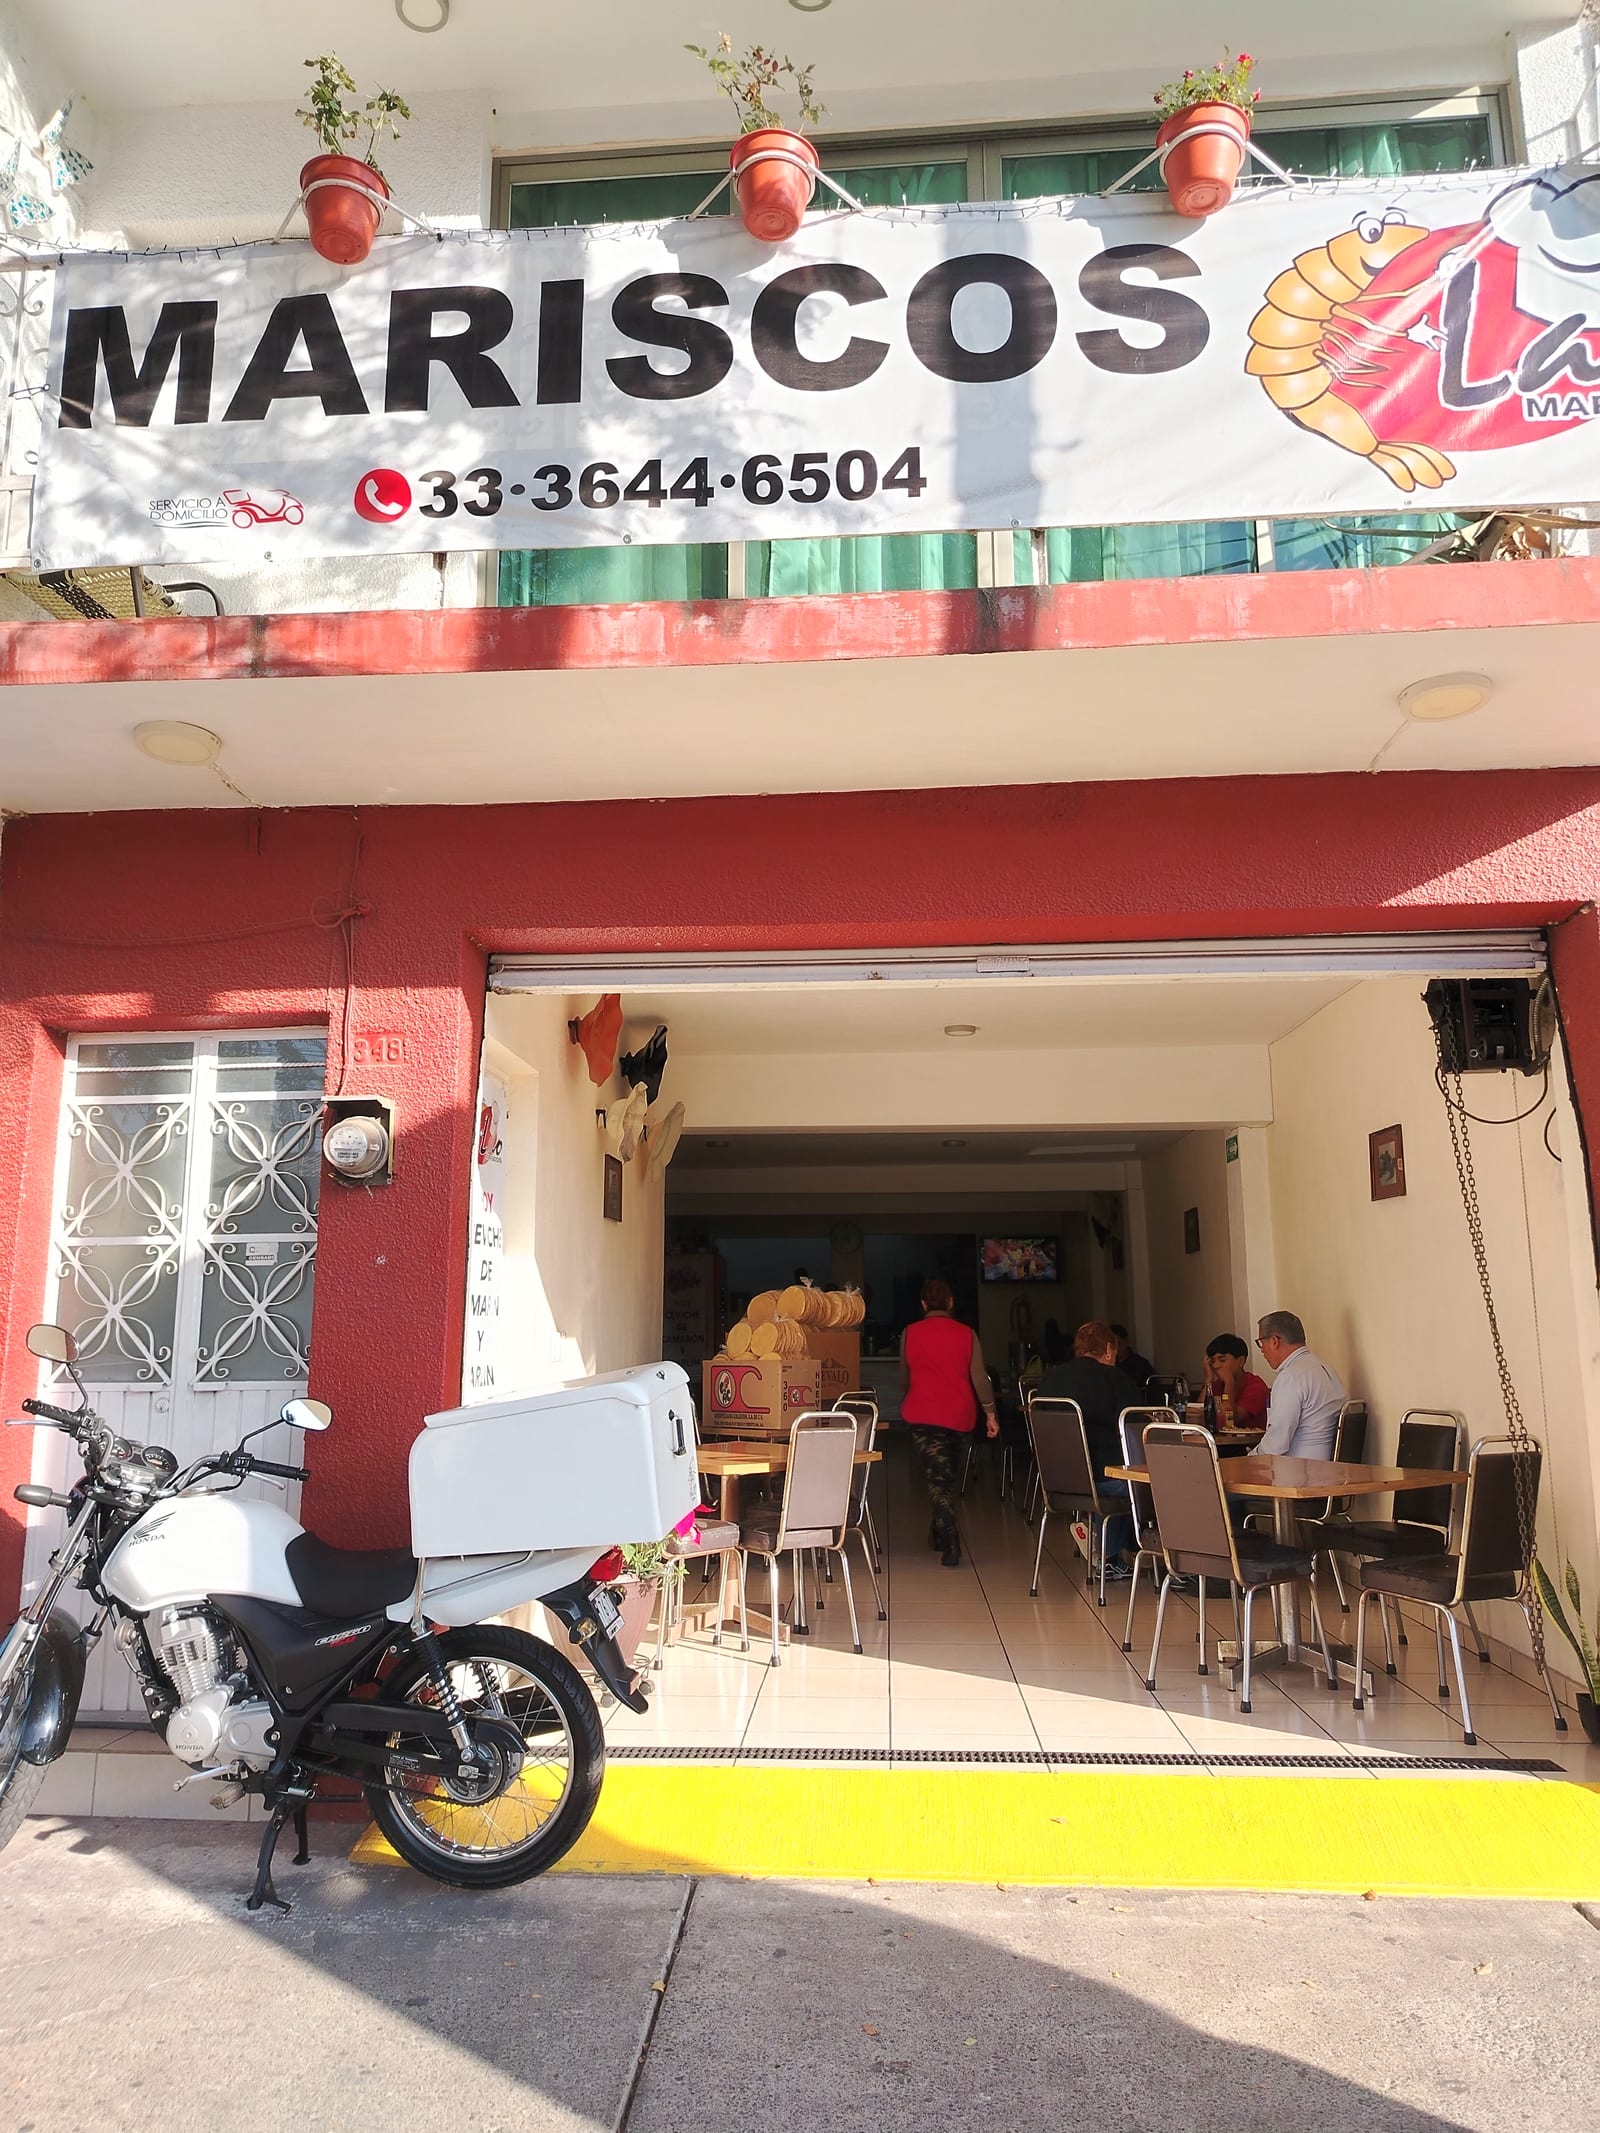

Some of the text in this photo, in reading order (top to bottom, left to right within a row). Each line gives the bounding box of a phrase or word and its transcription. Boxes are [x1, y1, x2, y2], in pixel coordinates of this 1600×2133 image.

[58, 243, 1211, 430] MARISCOS
[149, 497, 226, 511] SERVICIO A
[150, 508, 228, 521] DOMICILIO
[129, 1534, 166, 1547] HONDA
